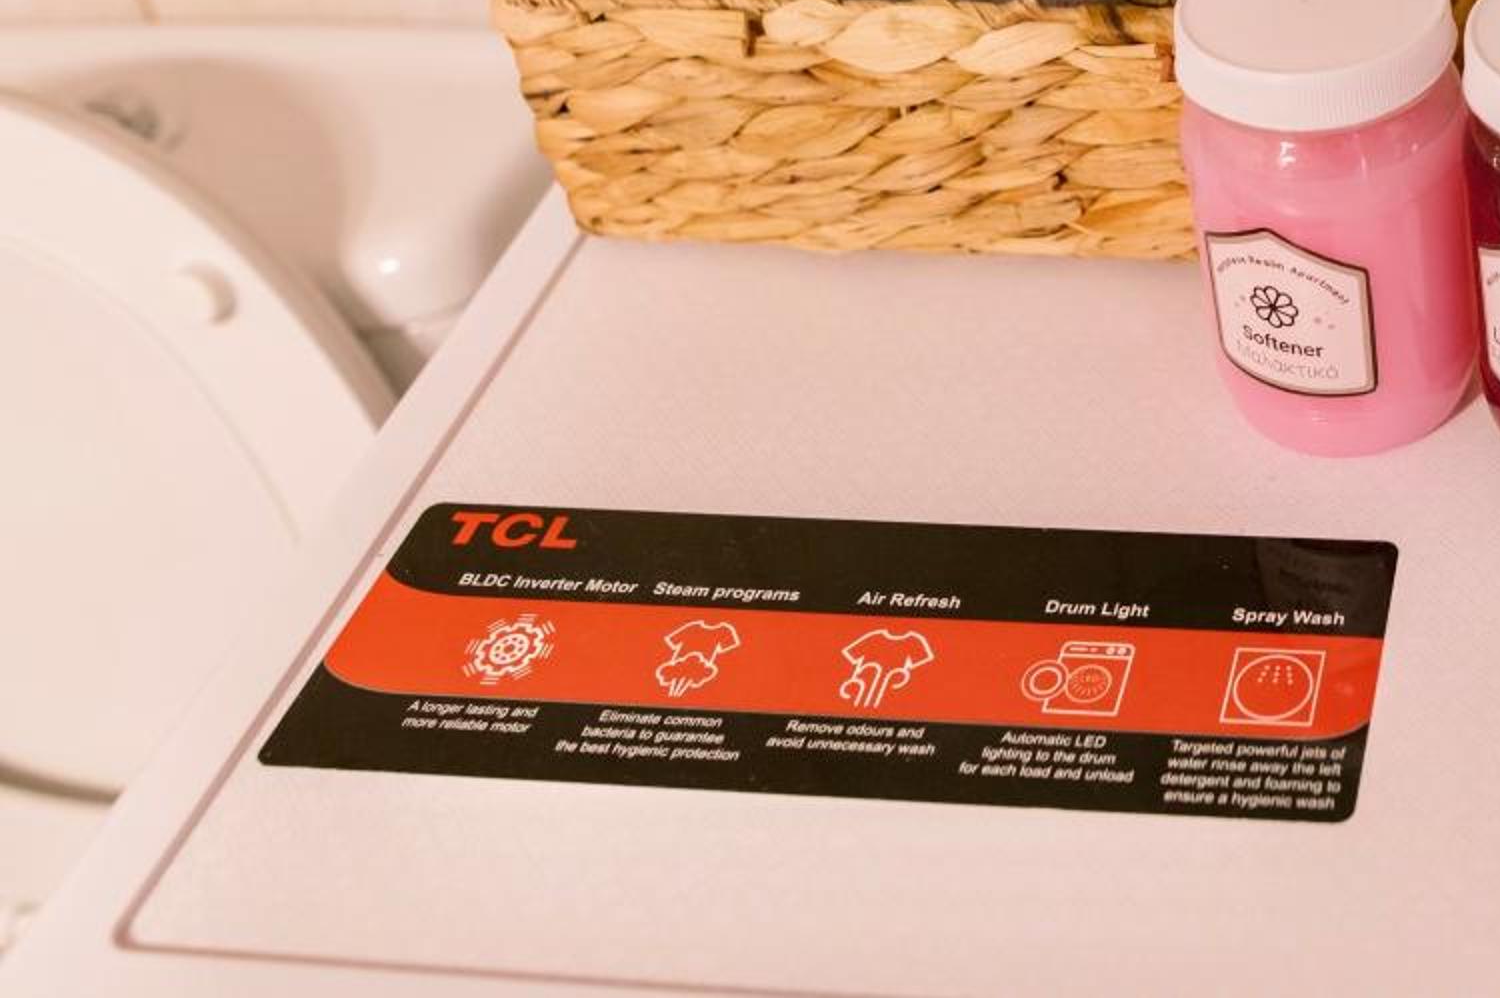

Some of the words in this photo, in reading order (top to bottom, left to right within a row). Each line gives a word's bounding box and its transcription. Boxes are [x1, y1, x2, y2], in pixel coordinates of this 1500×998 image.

[1242, 324, 1326, 358] Softener
[452, 510, 576, 549] TCL
[457, 572, 511, 587] BLDC
[512, 574, 583, 591] Inverter
[584, 578, 639, 593] Motor
[652, 581, 710, 597] Steam
[711, 586, 800, 602] programs
[856, 591, 887, 605] Air
[888, 592, 961, 609] Refresh
[1044, 598, 1096, 614] Drum
[1100, 601, 1150, 619] Light
[1231, 607, 1288, 626] Spray
[1292, 609, 1345, 625] Wash
[406, 699, 420, 711] A
[420, 700, 464, 715] longer
[464, 703, 510, 719] lasting
[510, 706, 539, 718] and
[598, 708, 662, 724] Eliminate
[662, 715, 723, 727] common
[400, 716, 438, 728] more
[438, 717, 489, 731] reliable
[489, 721, 531, 733] motor
[580, 724, 637, 739] bacteria
[637, 728, 653, 740] to
[653, 730, 725, 744] guarantee
[785, 719, 844, 734] Remove
[845, 723, 894, 737] odours
[896, 726, 925, 739] and
[765, 736, 806, 748] avoid
[806, 739, 895, 755] unnecessary
[897, 743, 935, 755] wash
[1000, 730, 1072, 746] Automatic
[1074, 734, 1107, 748] LED
[1172, 738, 1234, 755] Targeted
[1235, 743, 1298, 757] powerful
[1299, 746, 1327, 760] jets
[1329, 746, 1346, 760] of
[554, 739, 578, 752] the
[578, 740, 611, 754] best
[611, 741, 670, 758] hygienic
[669, 747, 740, 760] protection
[980, 745, 1033, 762] lighting
[1034, 749, 1050, 762] to
[1052, 749, 1076, 763] the
[1078, 750, 1116, 764] drum
[958, 760, 979, 774] for
[980, 763, 1017, 776] each
[1018, 762, 1052, 778] load
[1053, 766, 1082, 780] and
[1084, 767, 1134, 782] unload
[1167, 754, 1208, 769] water
[1210, 759, 1247, 772] rinse
[1249, 761, 1288, 776] away
[1291, 761, 1315, 775] the
[1318, 762, 1341, 776] left
[1159, 771, 1230, 788] detergent
[1232, 776, 1261, 789] and
[1263, 775, 1323, 795] foaming
[1326, 779, 1341, 793] to
[1163, 790, 1214, 804] ensure
[1217, 793, 1228, 804] a
[1230, 791, 1292, 808] hygienic
[1295, 796, 1335, 809] wash
